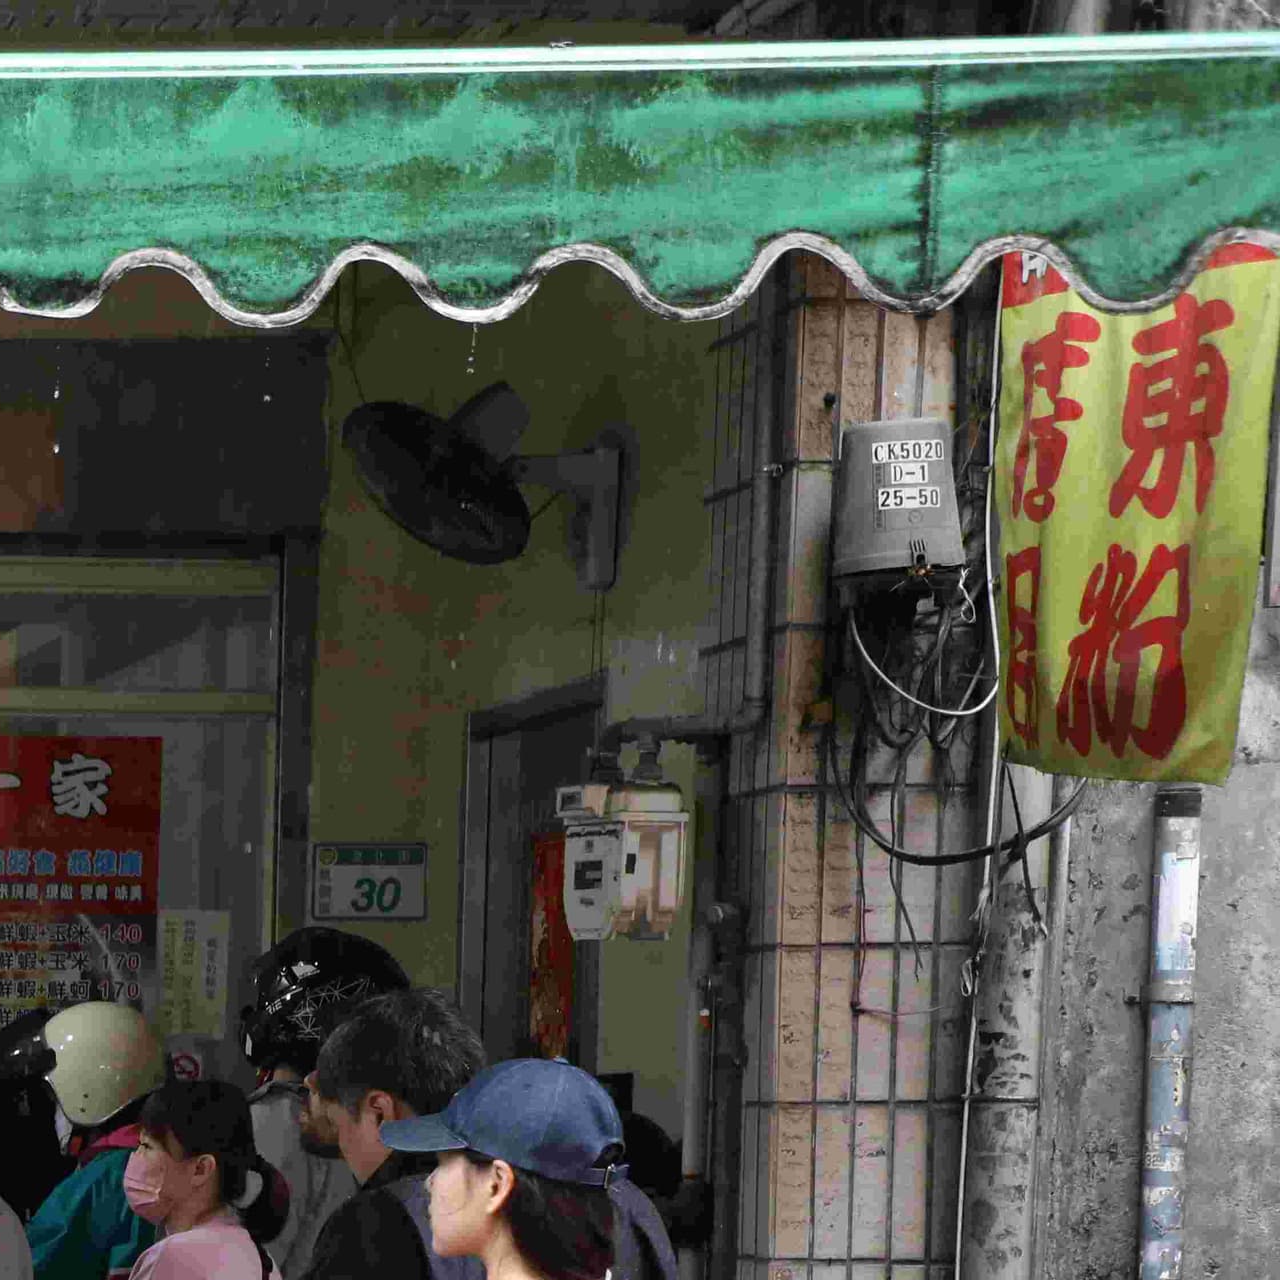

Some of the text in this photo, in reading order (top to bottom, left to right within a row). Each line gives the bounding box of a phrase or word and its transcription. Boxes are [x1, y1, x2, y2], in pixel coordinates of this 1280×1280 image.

[874, 441, 943, 463] CK5020
[893, 464, 927, 482] D-1
[880, 488, 939, 508] 25-50
[352, 877, 401, 912] 30
